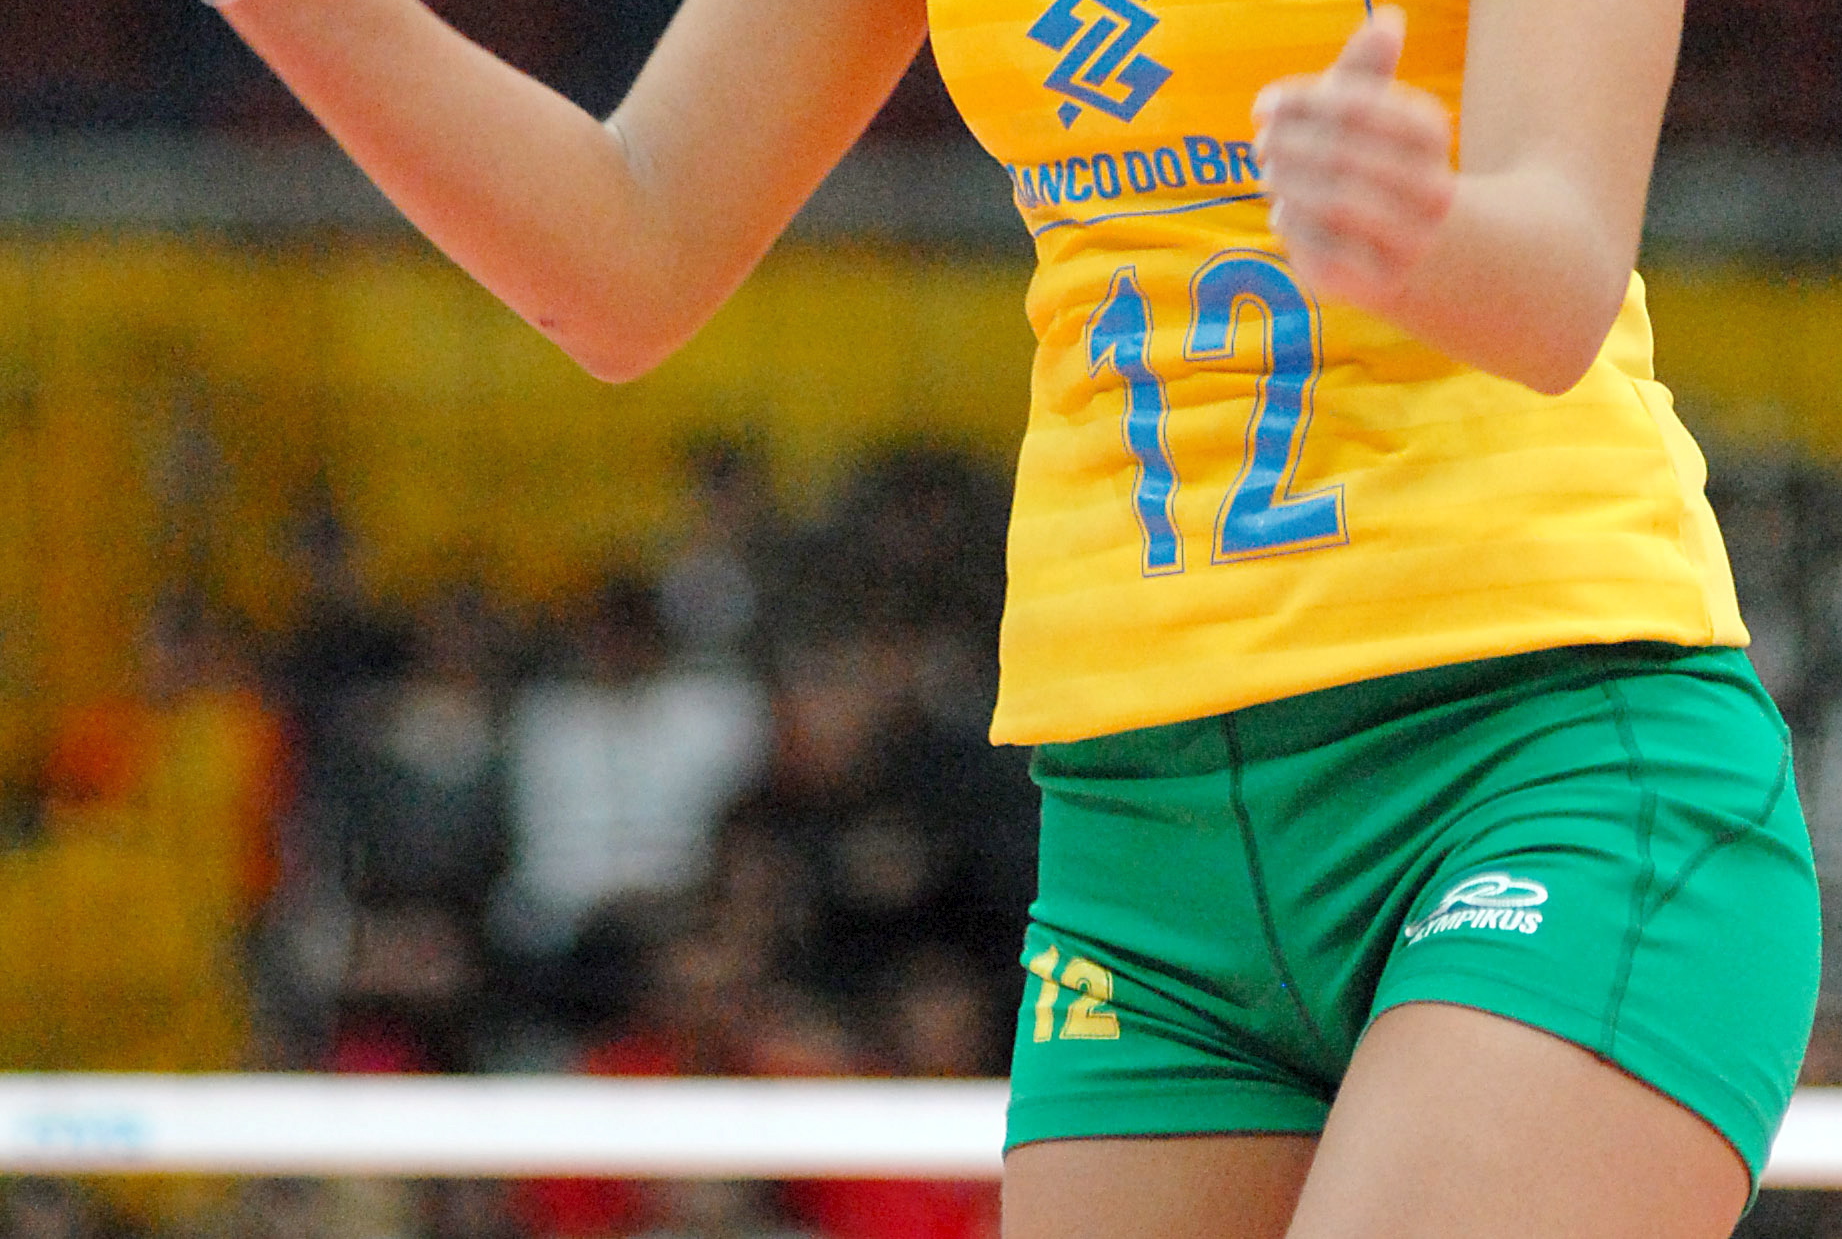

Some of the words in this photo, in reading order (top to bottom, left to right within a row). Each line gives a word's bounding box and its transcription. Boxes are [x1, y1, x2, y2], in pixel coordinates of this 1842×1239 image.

[1006, 153, 1122, 209] ANCO
[1123, 146, 1187, 195] DO
[1086, 248, 1349, 578] 12
[1029, 943, 1120, 1043] 12
